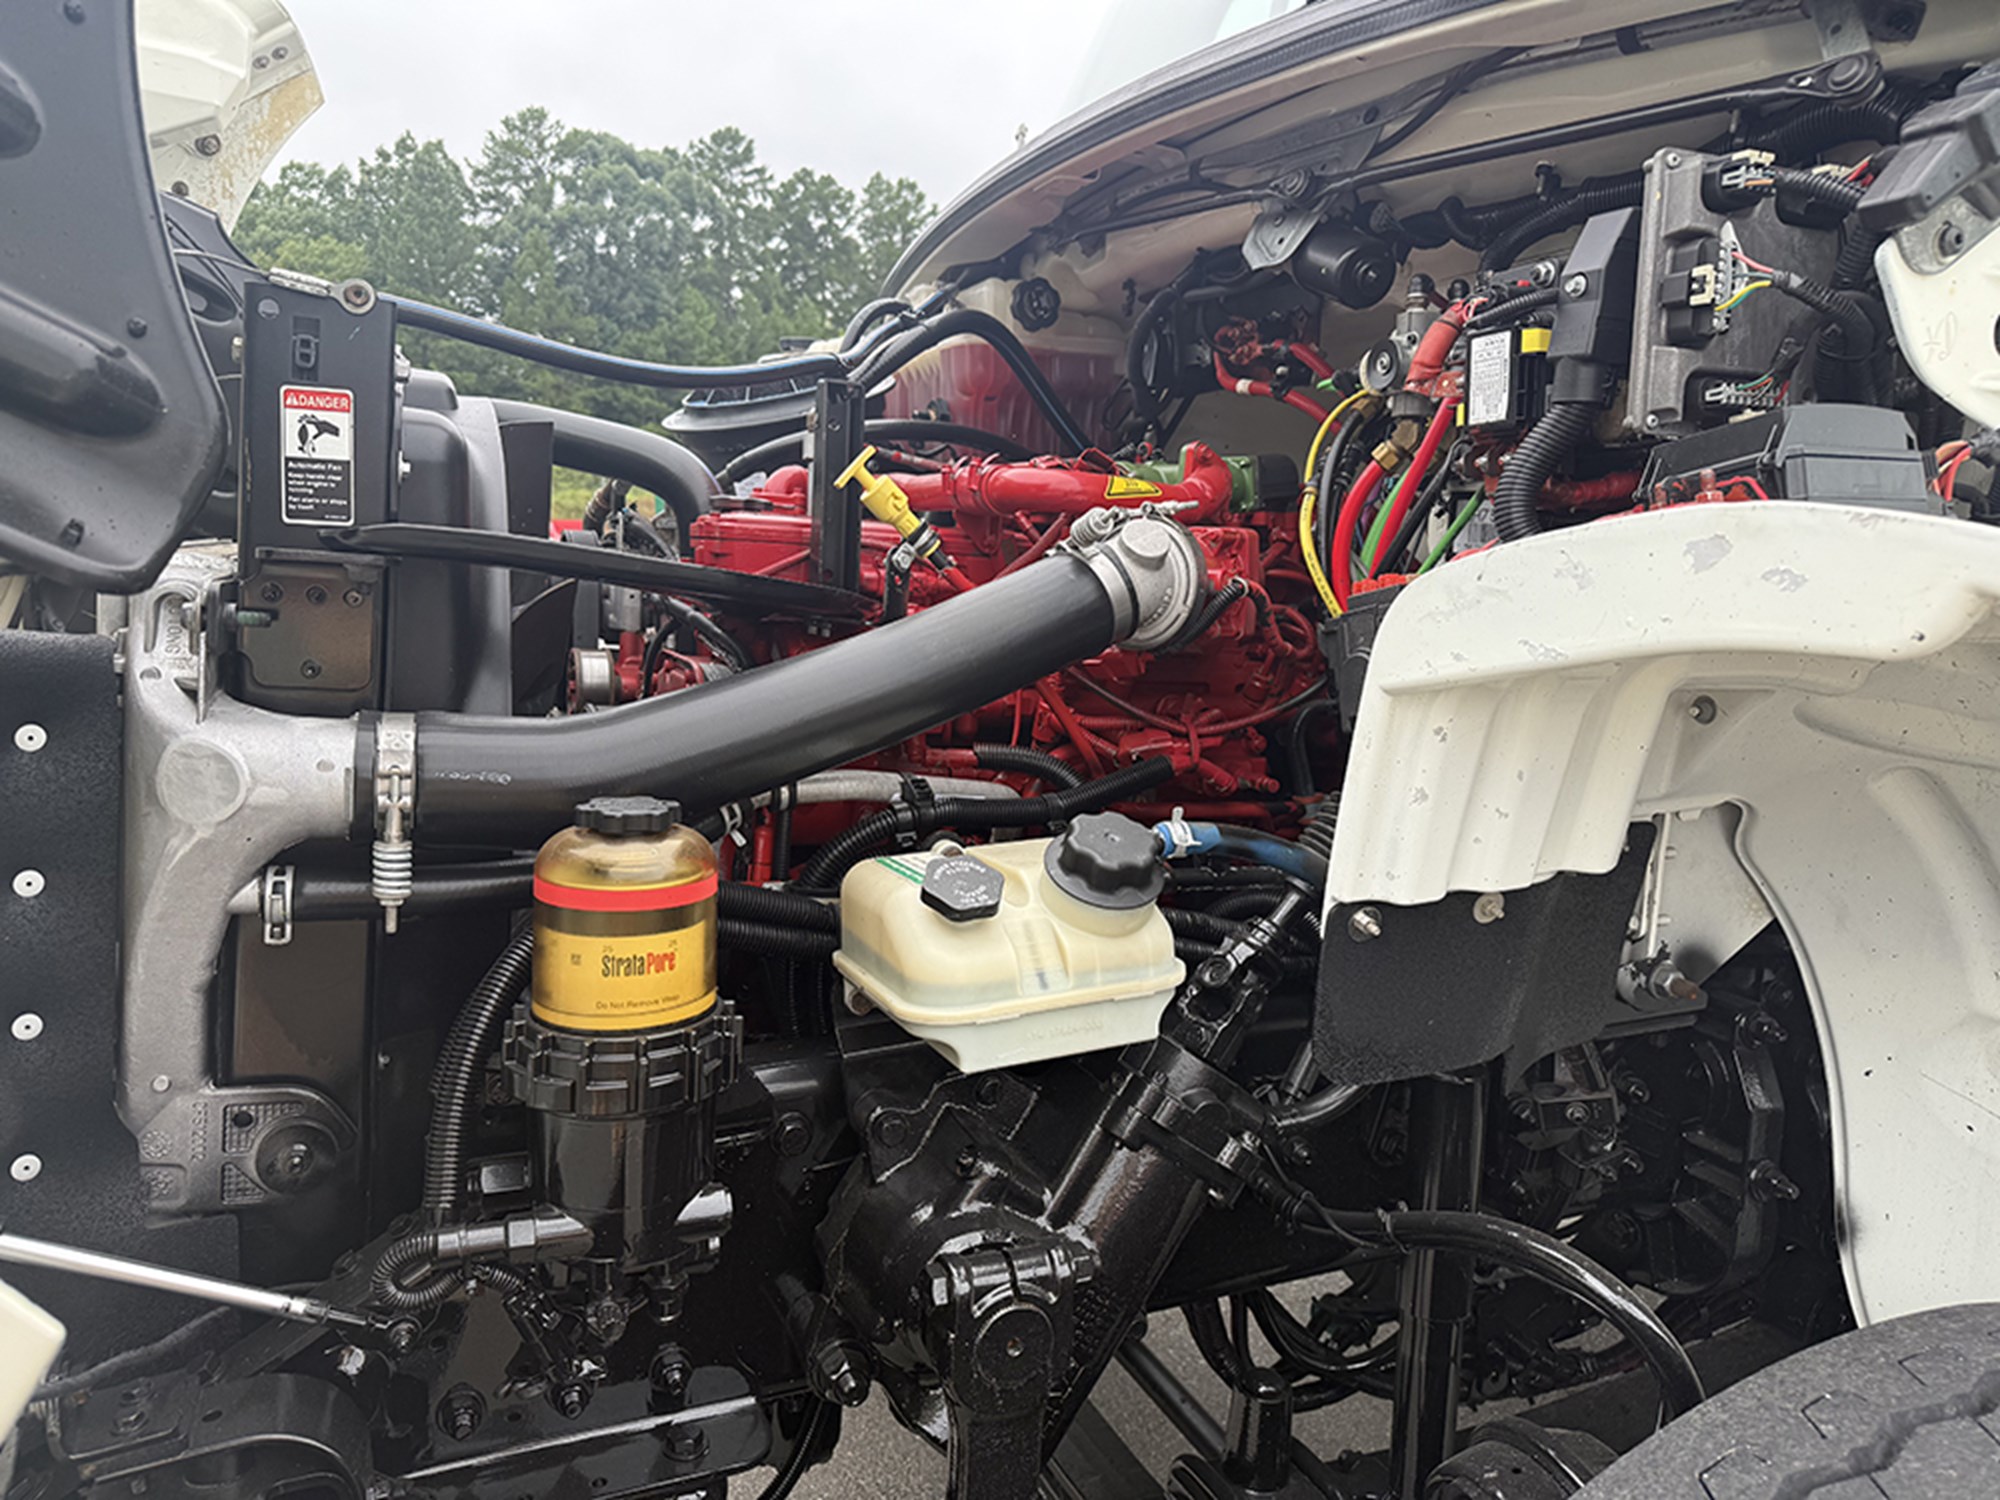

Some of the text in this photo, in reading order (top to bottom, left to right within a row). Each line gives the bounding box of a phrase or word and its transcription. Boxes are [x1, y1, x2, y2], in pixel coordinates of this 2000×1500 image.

[298, 394, 349, 410] DANGER
[287, 461, 342, 471] Automatic Fan
[601, 952, 675, 977] StrataPore
[595, 1001, 608, 1010] Do
